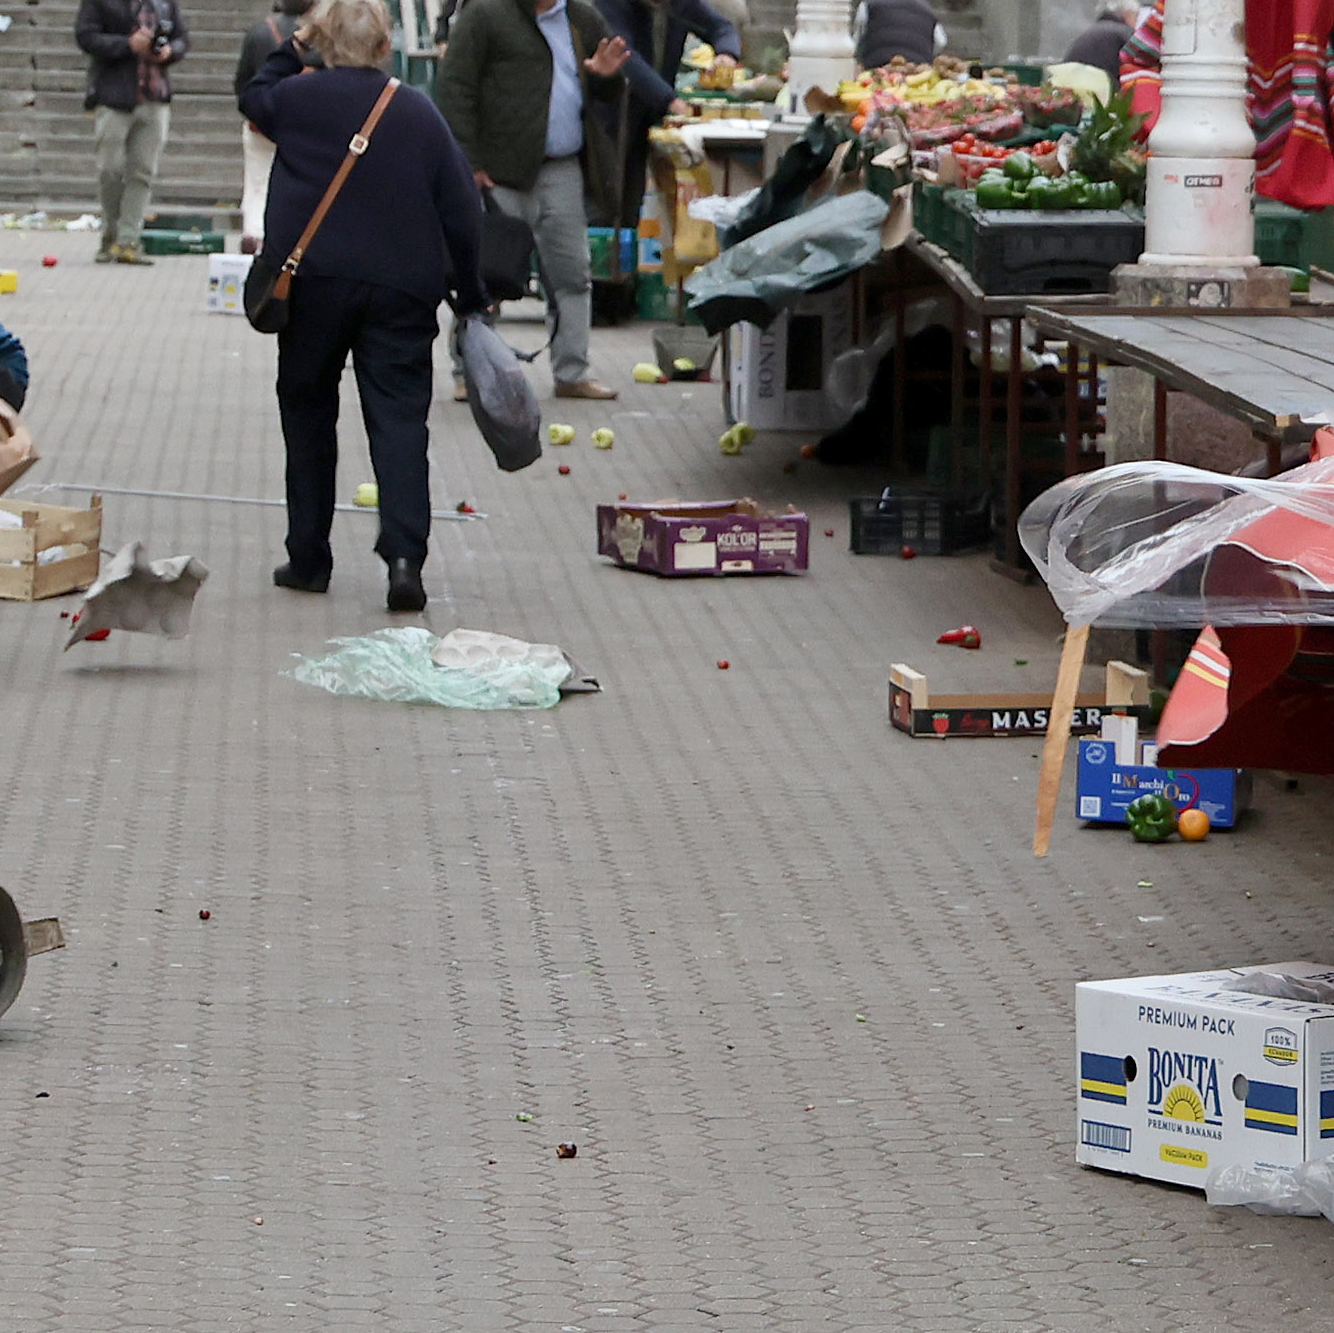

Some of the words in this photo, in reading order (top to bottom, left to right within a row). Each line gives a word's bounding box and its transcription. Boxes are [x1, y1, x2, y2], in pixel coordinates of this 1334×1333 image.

[992, 708, 1101, 729] MASER
[1138, 1005, 1197, 1030] PREMIUM
[1202, 1016, 1236, 1036] PACK
[1270, 1035, 1291, 1047] 100%
[1147, 1047, 1223, 1117] BONITA
[1147, 1118, 1183, 1134] PREMIUM
[1185, 1125, 1223, 1141] BANANAS
